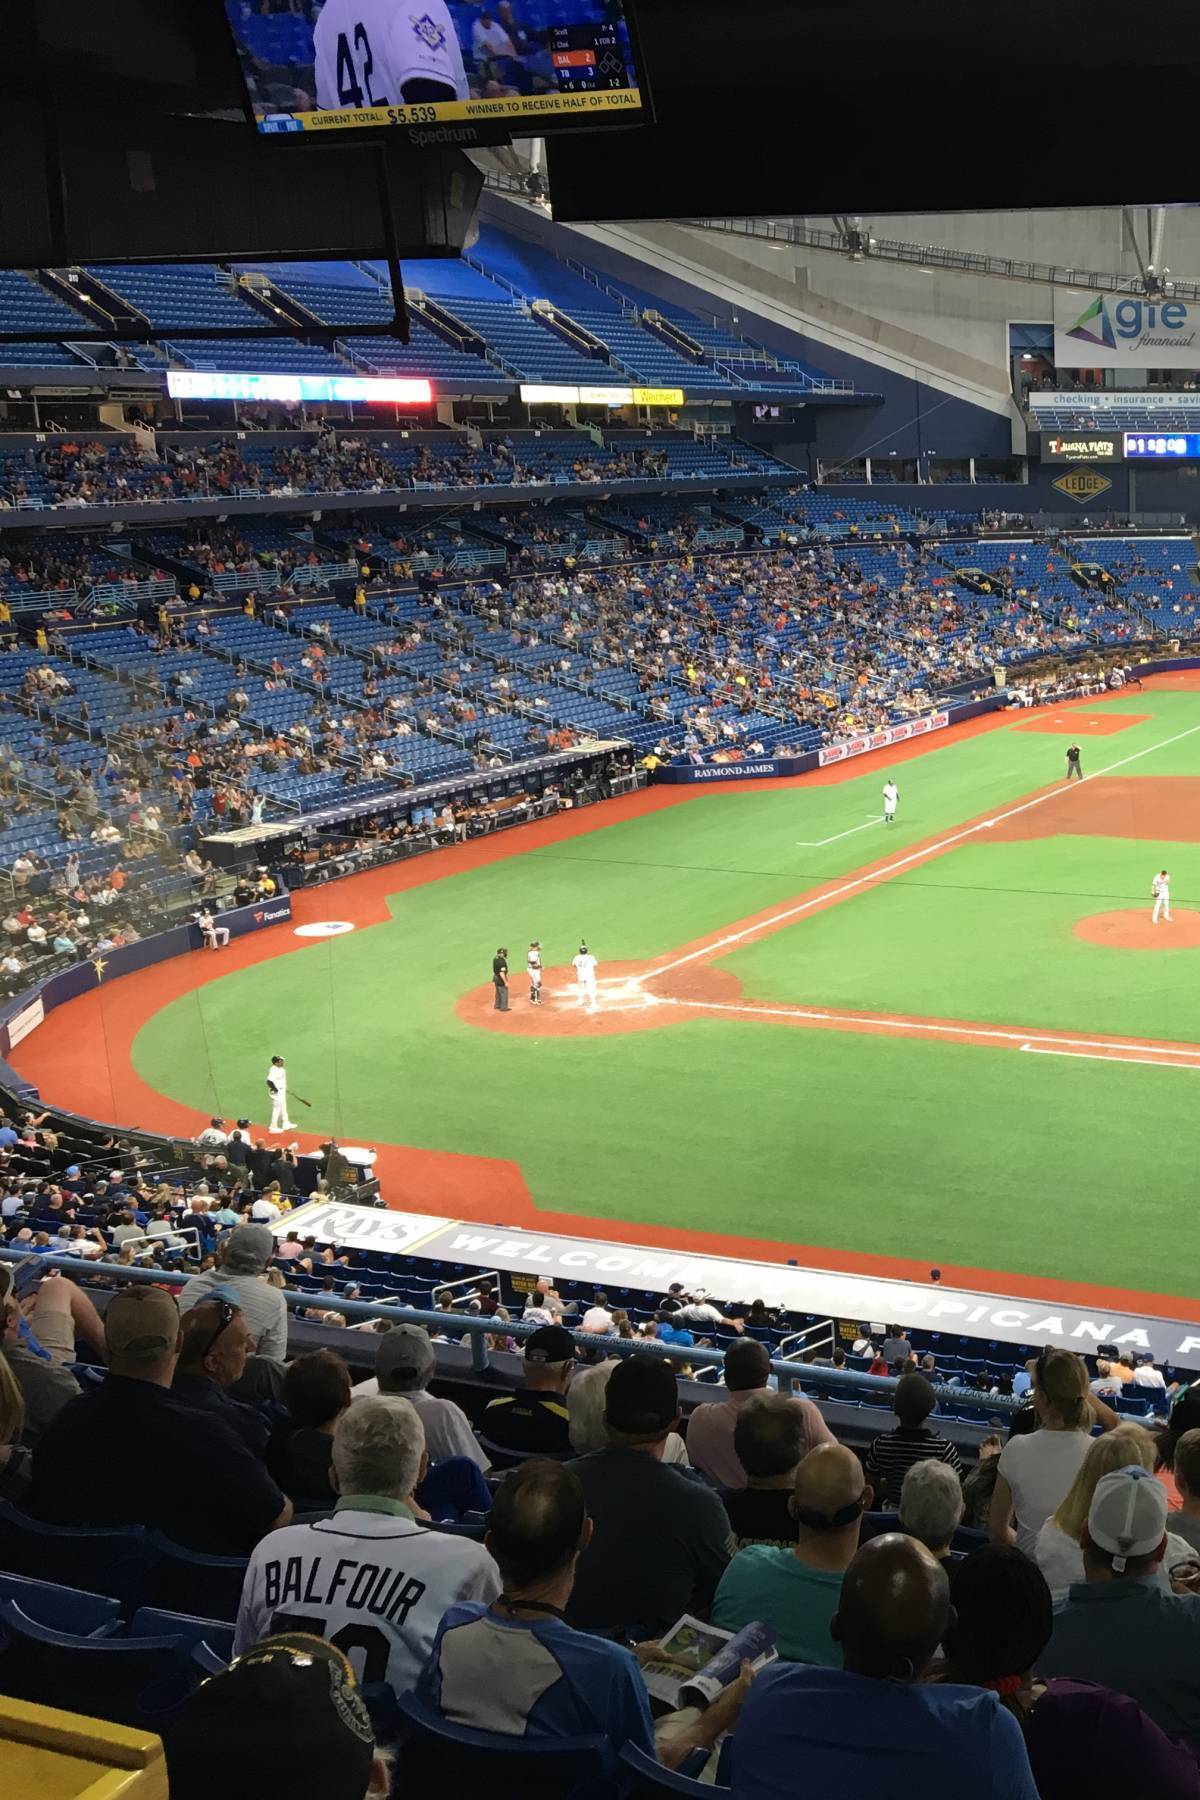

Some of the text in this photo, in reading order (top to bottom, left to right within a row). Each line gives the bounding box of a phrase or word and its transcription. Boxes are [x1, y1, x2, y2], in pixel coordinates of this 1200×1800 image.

[336, 22, 390, 108] 42
[557, 53, 592, 64] BAL 2
[560, 67, 594, 78] TB 3
[466, 94, 636, 114] WINNER TO RECEIVE HALF OF TOTAL
[312, 114, 351, 126] CURRENT
[409, 125, 478, 148] Spectrum
[1129, 331, 1196, 351] financial
[1054, 394, 1101, 405] checking
[1113, 394, 1164, 404] insurance
[1049, 438, 1089, 453] TIJUANA
[1089, 441, 1113, 452] FLATS
[1065, 476, 1098, 491] LEDGE
[694, 764, 775, 779] RAYMOND JAMES
[263, 908, 291, 921] Fanatics
[301, 1207, 418, 1242] RAYS
[265, 1556, 426, 1626] BALFOUR
